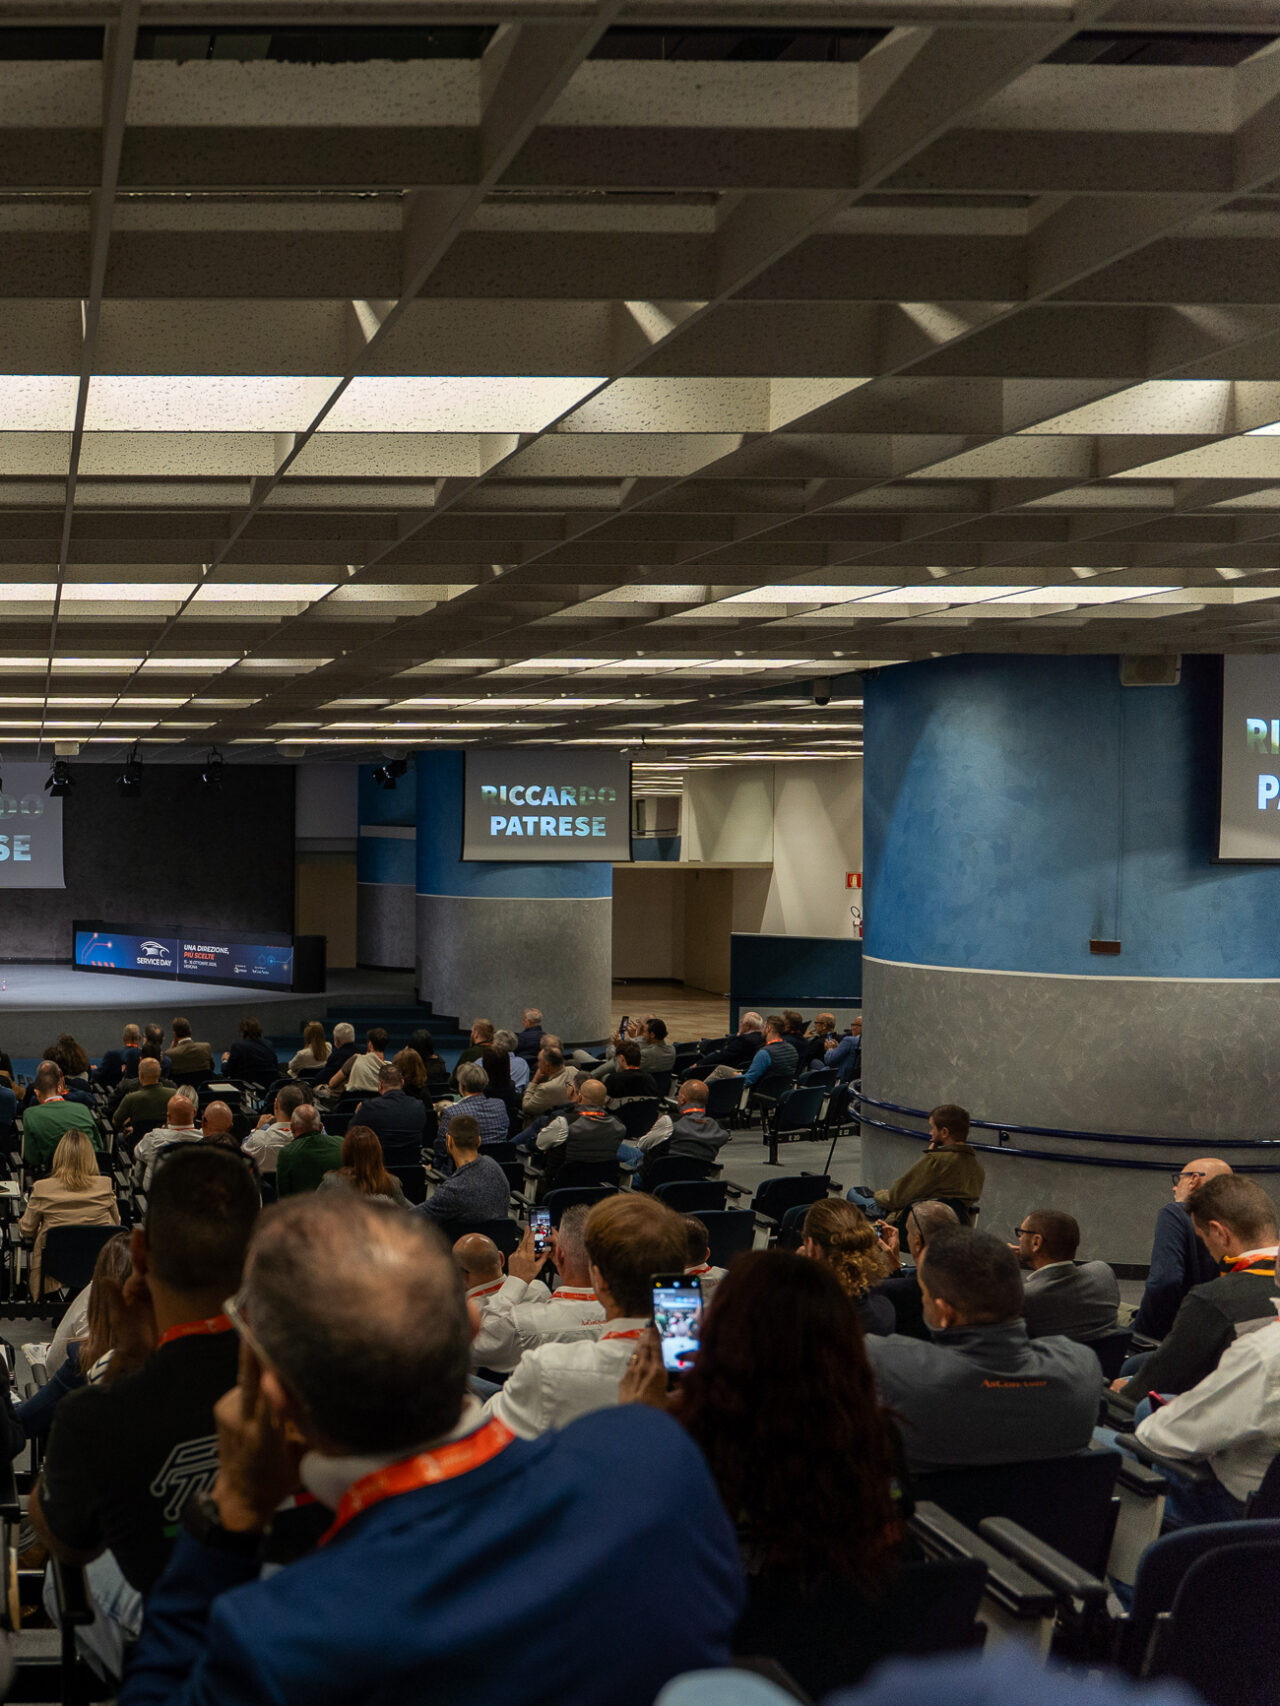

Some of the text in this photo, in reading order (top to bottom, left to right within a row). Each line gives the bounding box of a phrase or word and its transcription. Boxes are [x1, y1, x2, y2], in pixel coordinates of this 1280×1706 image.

[480, 784, 617, 807] RICCARDO
[489, 815, 607, 837] PATRESE
[136, 957, 173, 967] SERVICE DAY
[194, 952, 216, 960] SCELTE
